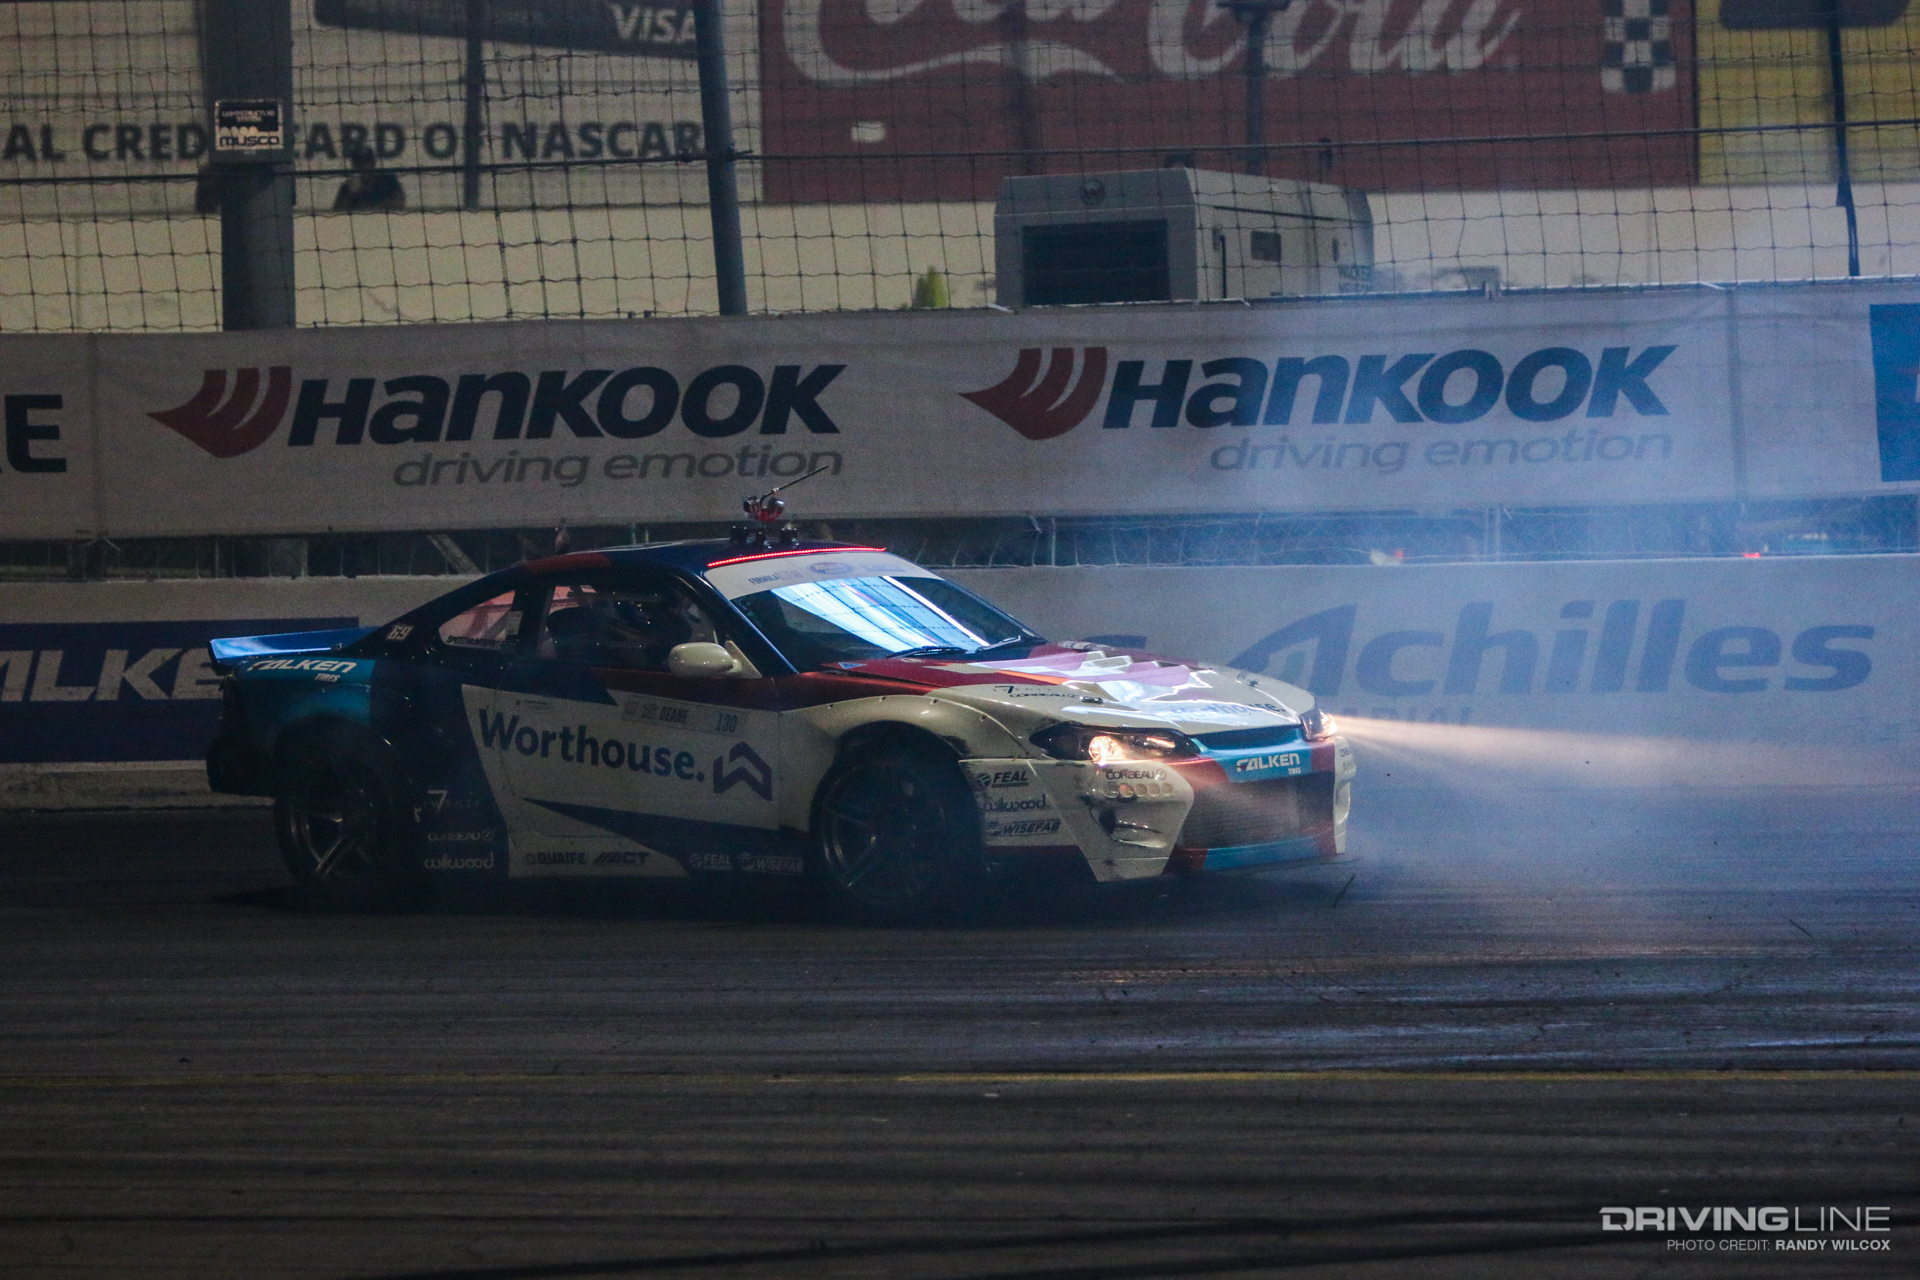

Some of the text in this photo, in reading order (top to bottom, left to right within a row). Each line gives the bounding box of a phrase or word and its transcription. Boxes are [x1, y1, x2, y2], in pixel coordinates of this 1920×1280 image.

[83, 122, 207, 161] CRED
[294, 122, 406, 160] ARD
[502, 121, 704, 160] NASCAR
[0, 394, 68, 473] E
[1209, 427, 1673, 475] driving emotion
[392, 443, 842, 487] driving emotion
[1229, 598, 1876, 699] Achilles
[659, 705, 690, 724] DEANE
[478, 706, 705, 783] Worthouse.
[993, 771, 1029, 784] FEAL
[1105, 769, 1155, 783] CORBEAU
[1003, 820, 1062, 835] WISEFAB
[703, 853, 732, 866] FEAL
